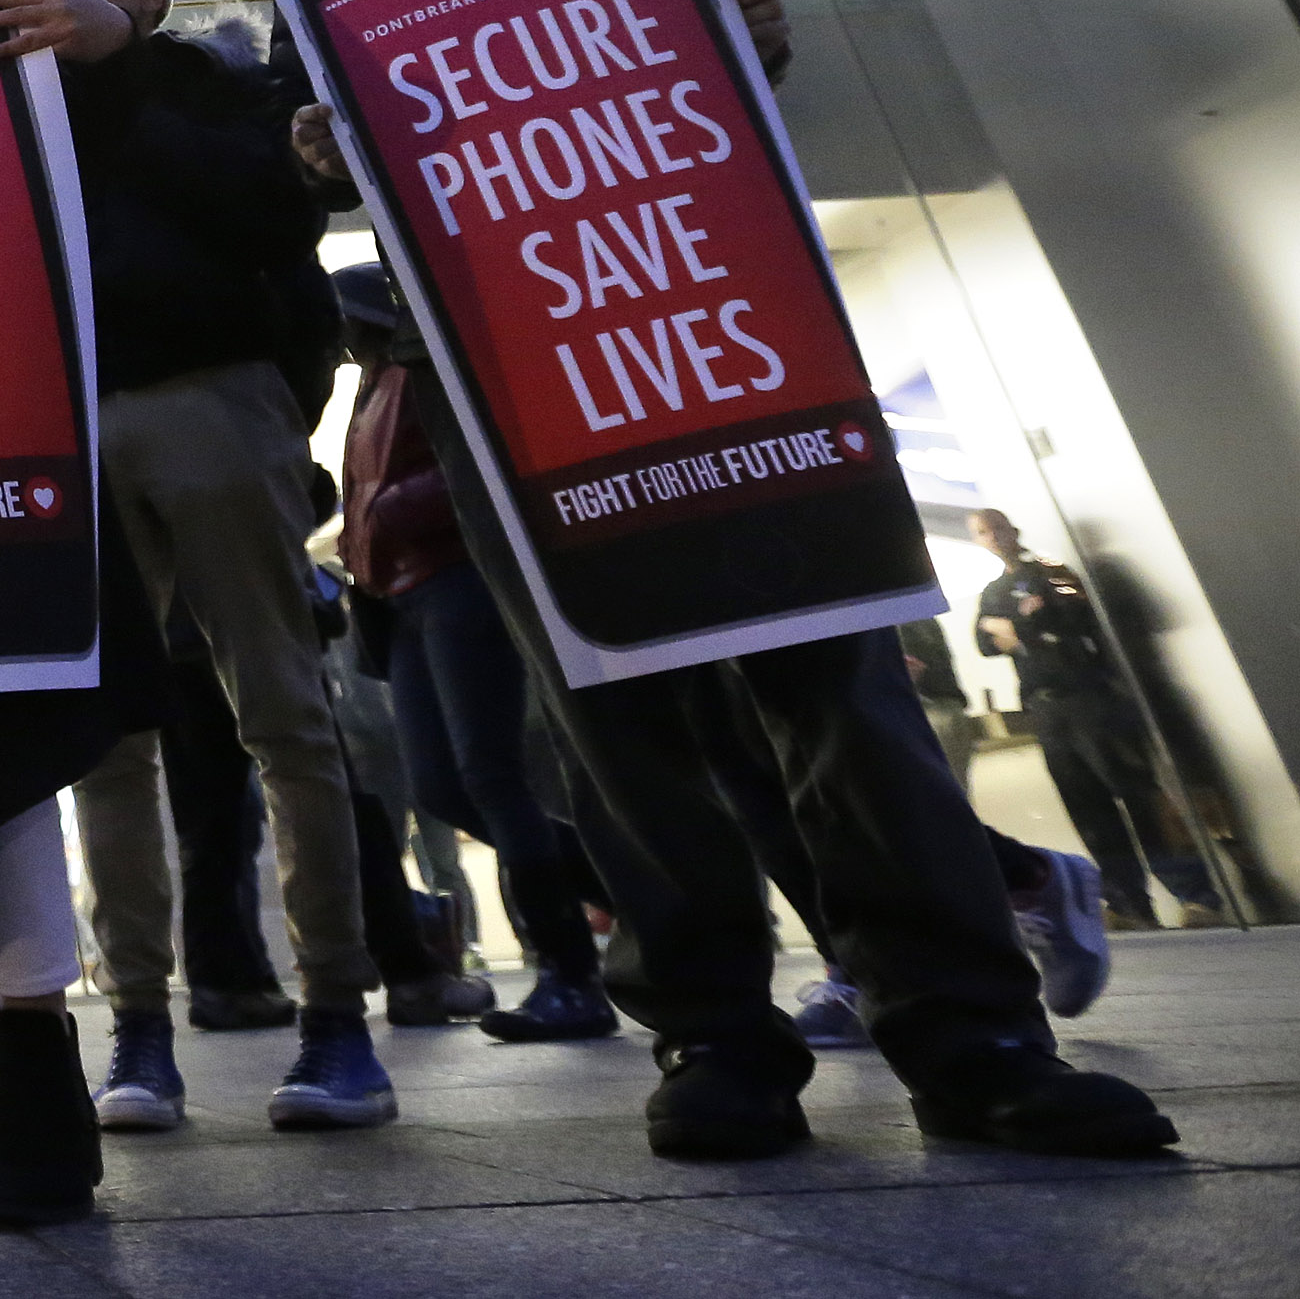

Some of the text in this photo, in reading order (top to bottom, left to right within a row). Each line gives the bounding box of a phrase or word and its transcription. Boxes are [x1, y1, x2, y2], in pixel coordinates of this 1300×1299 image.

[418, 79, 732, 237] PHONES
[520, 194, 728, 319] SAVE
[555, 299, 786, 433] LIVES
[553, 473, 637, 526] FIGHT
[721, 429, 843, 484] FUTURE
